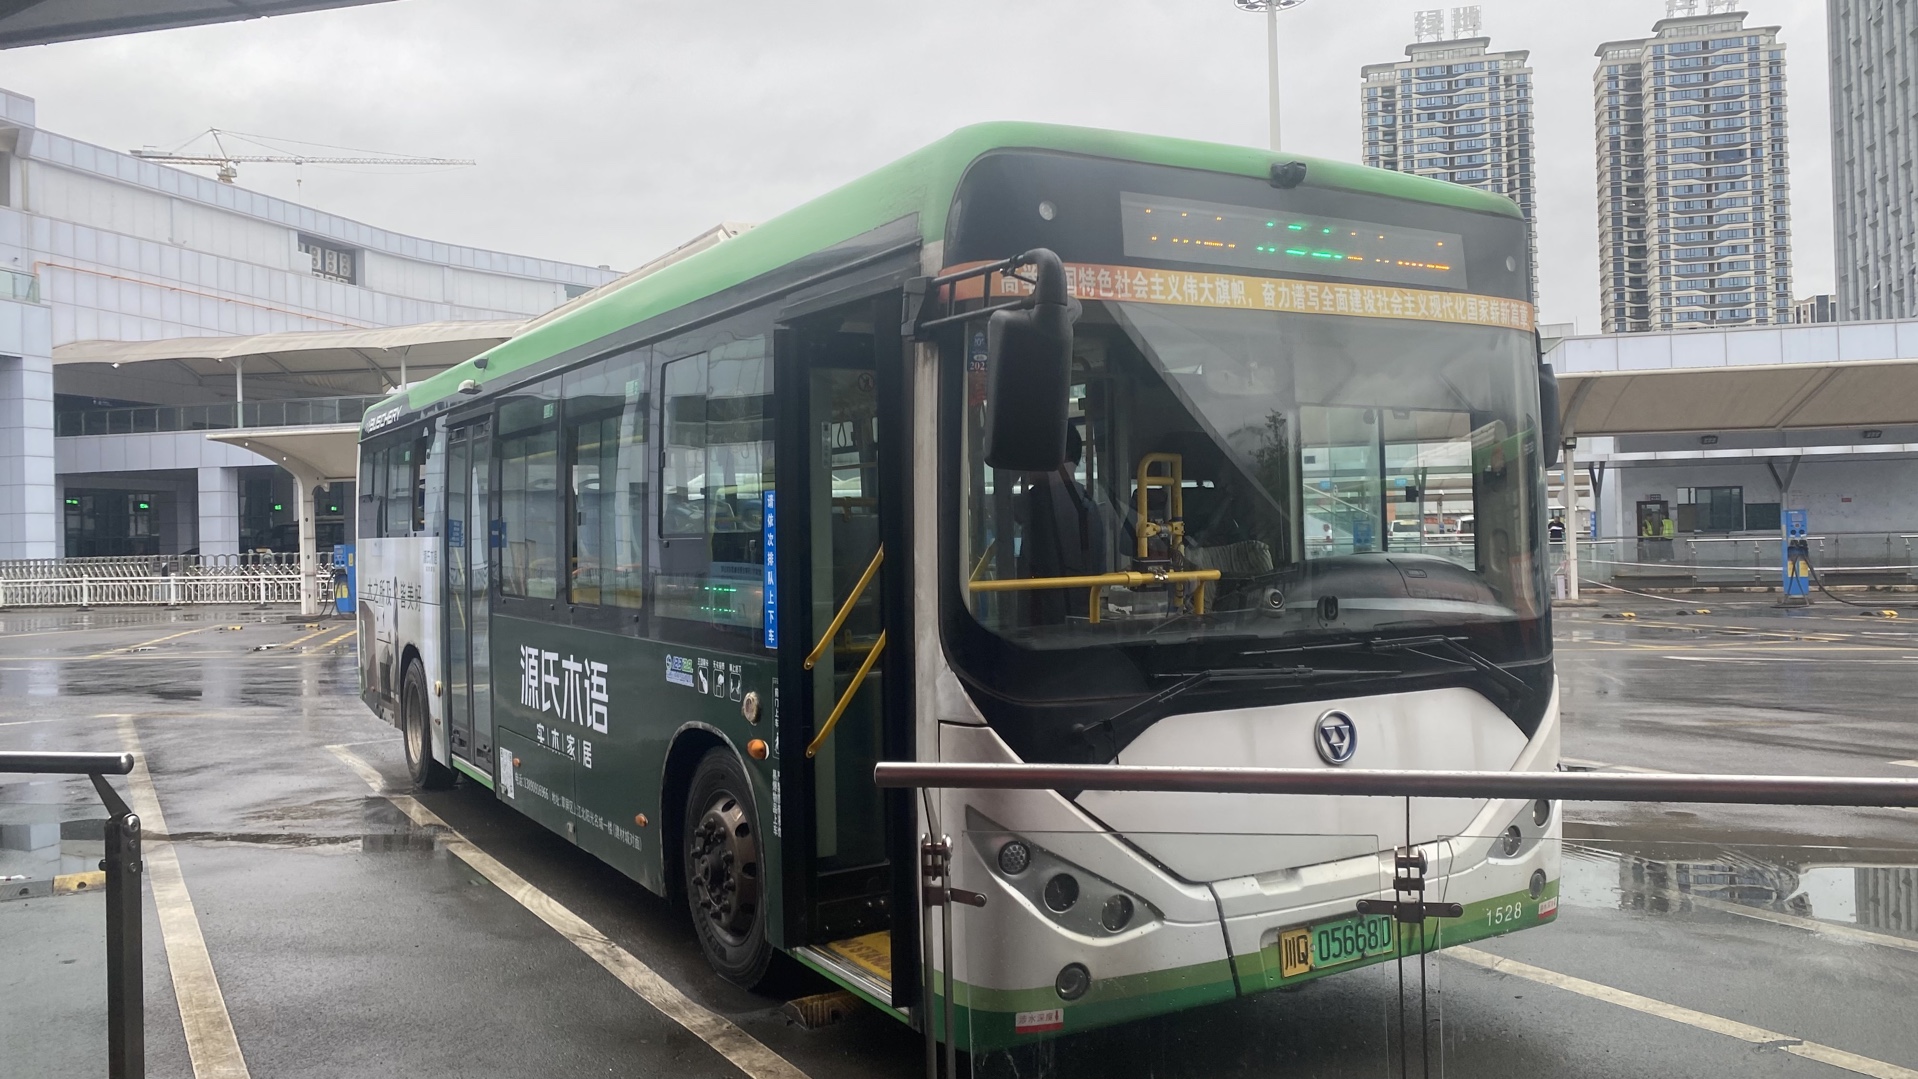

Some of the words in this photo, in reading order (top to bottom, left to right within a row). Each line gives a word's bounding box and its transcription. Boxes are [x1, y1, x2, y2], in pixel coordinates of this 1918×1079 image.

[767, 494, 775, 644] 请依次排队上下车
[520, 644, 609, 735] 源氏木语
[1486, 902, 1522, 926] 1528
